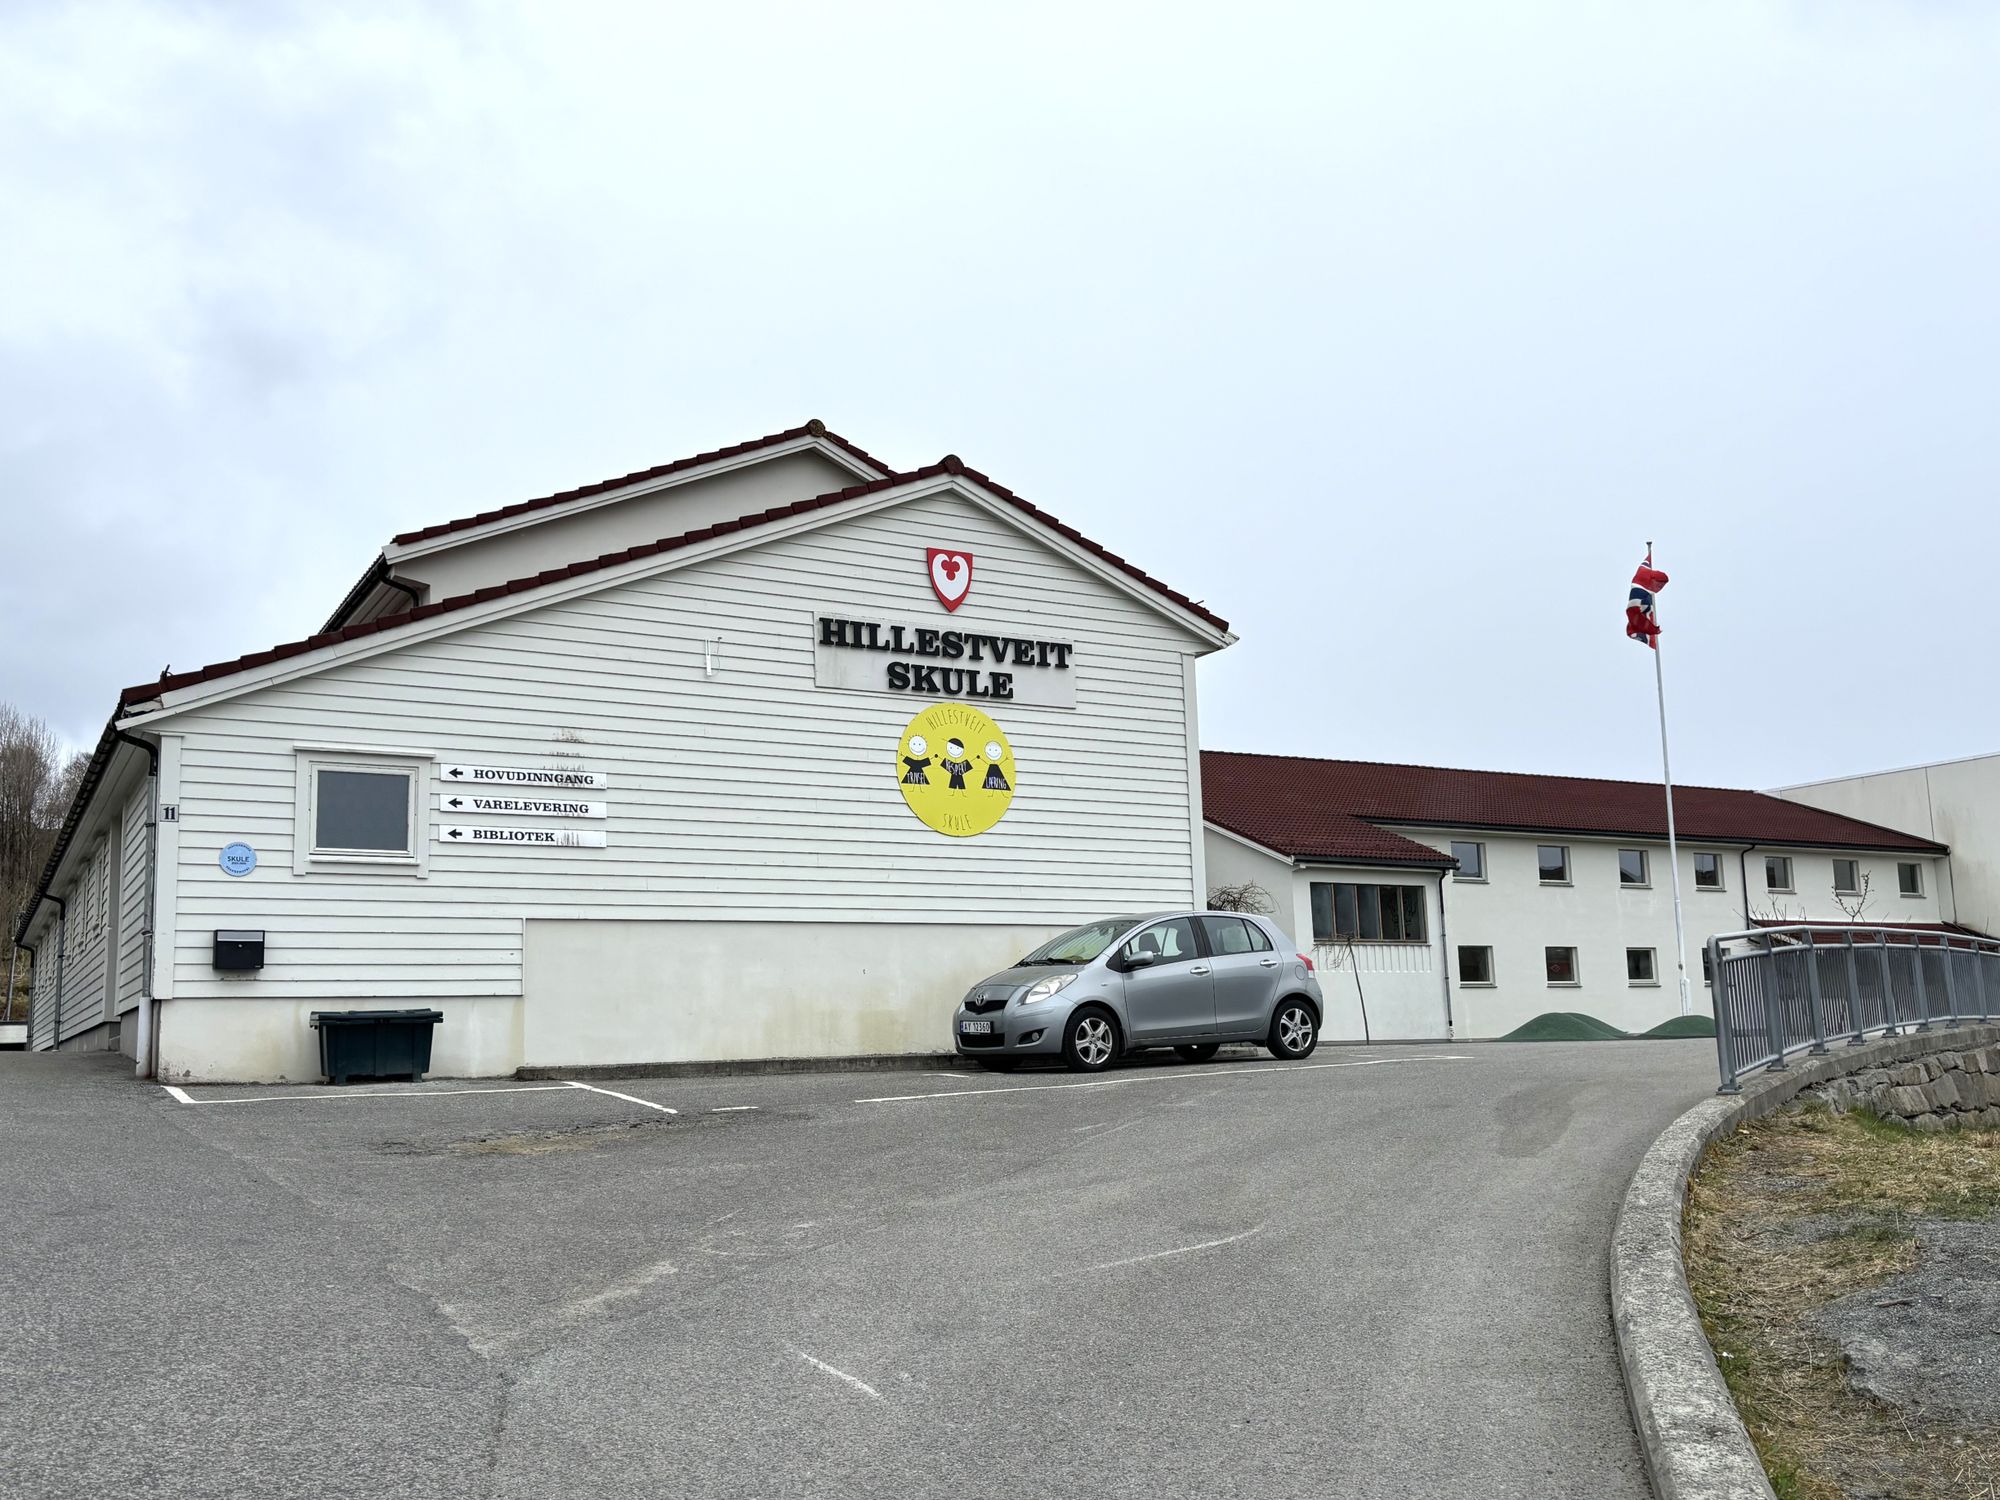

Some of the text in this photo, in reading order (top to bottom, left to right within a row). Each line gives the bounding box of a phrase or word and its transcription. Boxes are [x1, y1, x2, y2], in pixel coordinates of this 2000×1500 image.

[819, 617, 1073, 668] HILLESTVEIT
[887, 662, 1014, 698] SKULE
[926, 709, 987, 734] HILLESTVEIT
[473, 769, 594, 785] HOVUDINNGANG
[163, 807, 175, 820] 11
[473, 799, 589, 814] VARELEVERING
[943, 813, 972, 831] SKULE
[473, 829, 555, 842] BIBLIOTEK
